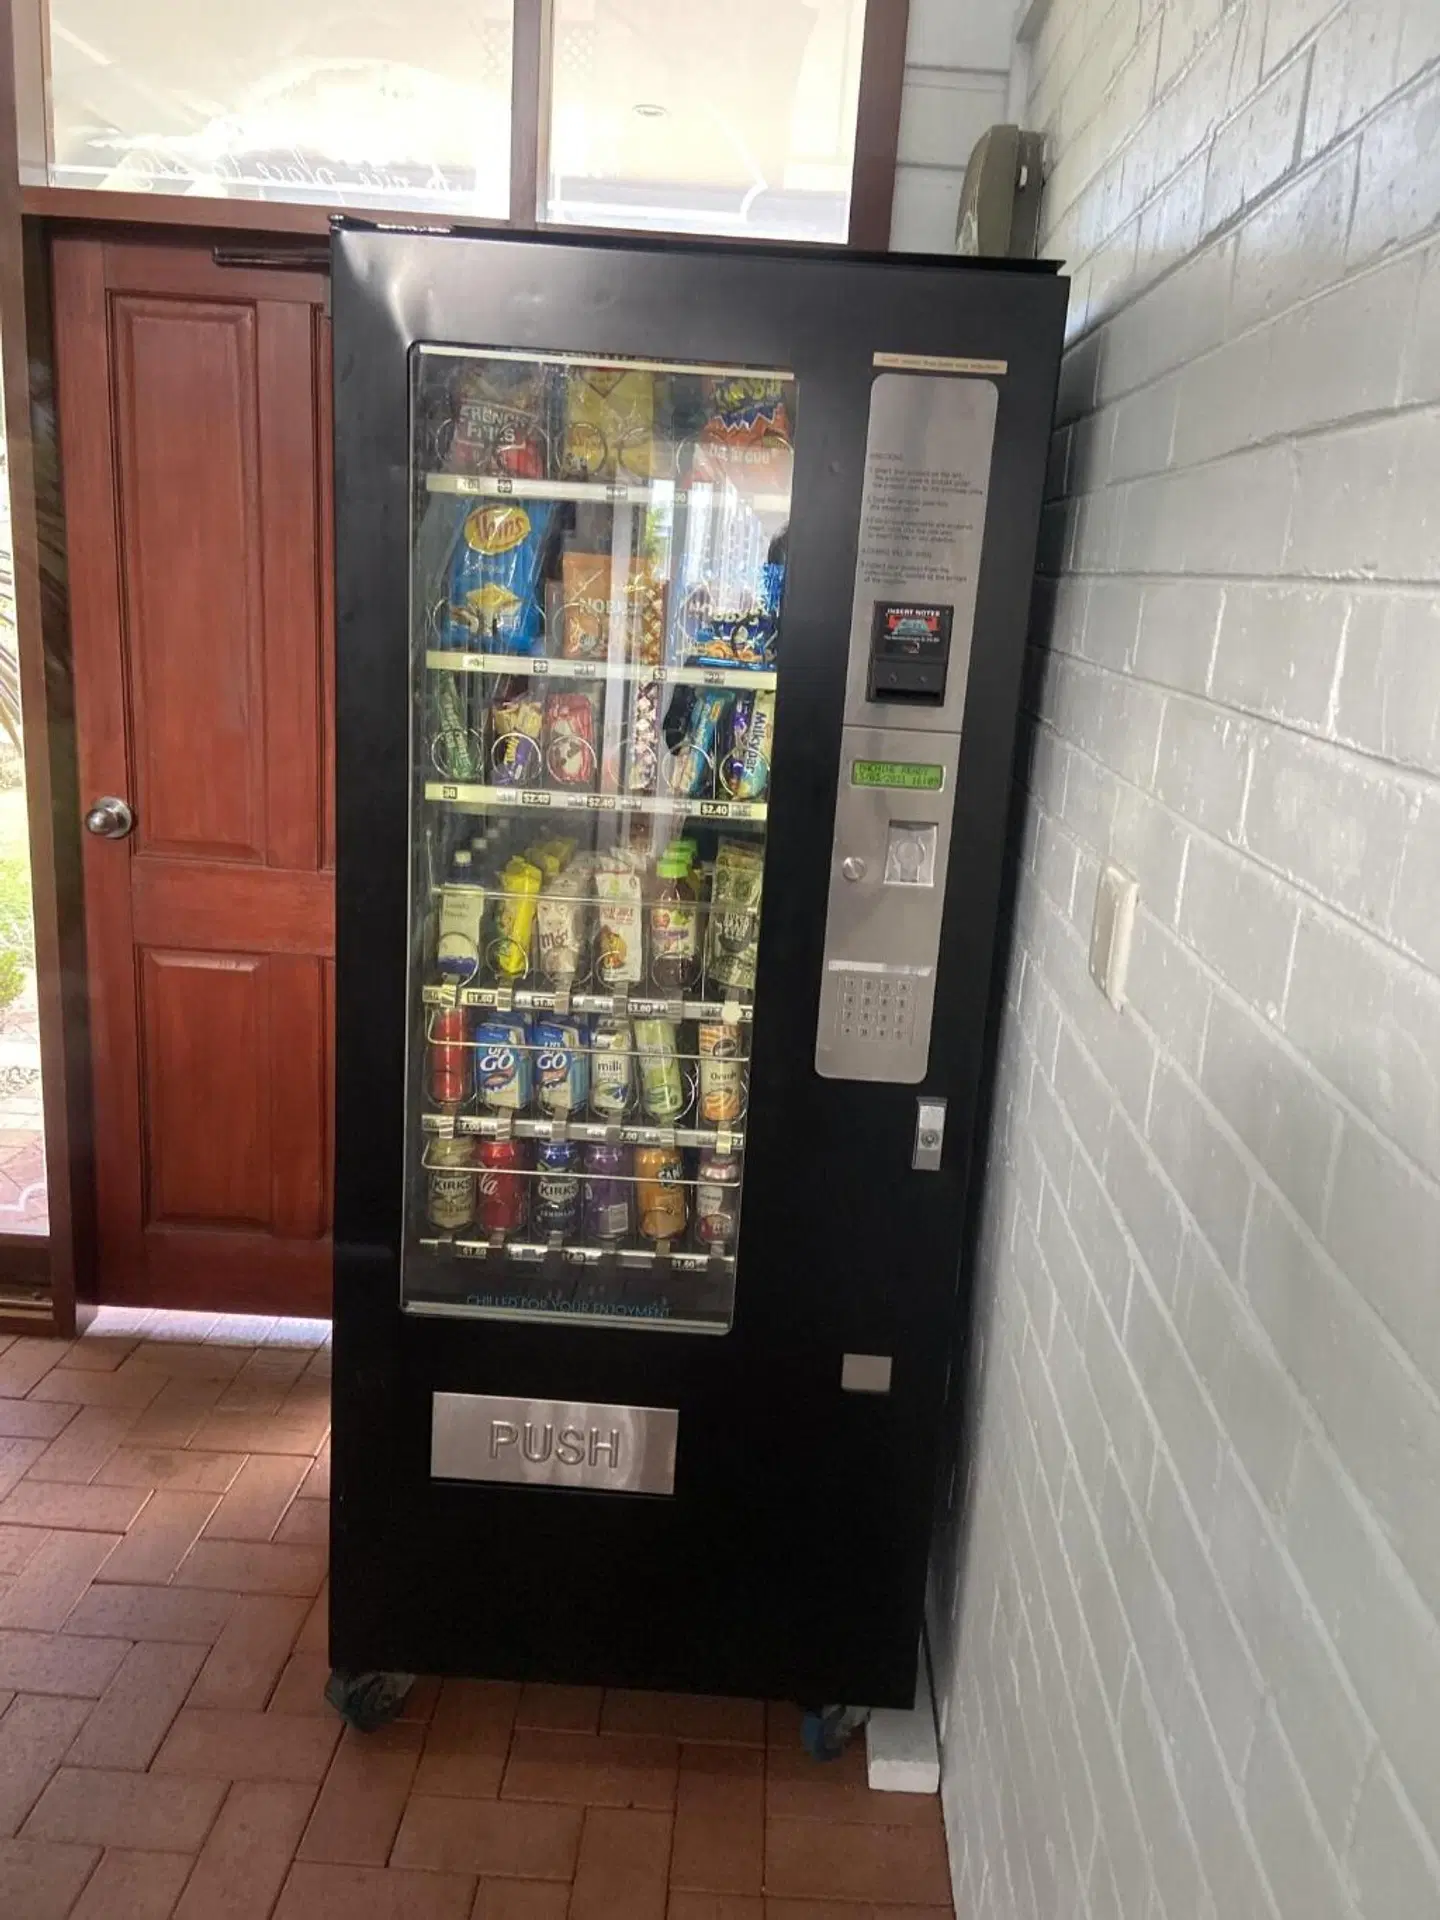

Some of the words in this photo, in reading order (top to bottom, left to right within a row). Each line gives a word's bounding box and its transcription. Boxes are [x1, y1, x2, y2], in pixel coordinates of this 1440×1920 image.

[887, 607, 914, 616] INSERT
[701, 804, 728, 815] $2.40
[480, 1052, 515, 1072] GO
[537, 1052, 568, 1070] GO
[434, 1178, 471, 1192] KIRKS
[540, 1183, 578, 1197] KIRKS
[521, 1297, 549, 1312] FOR
[551, 1299, 589, 1315] YOUR
[592, 1302, 672, 1320] ENJOYMENT
[488, 1418, 621, 1469] PUSH
